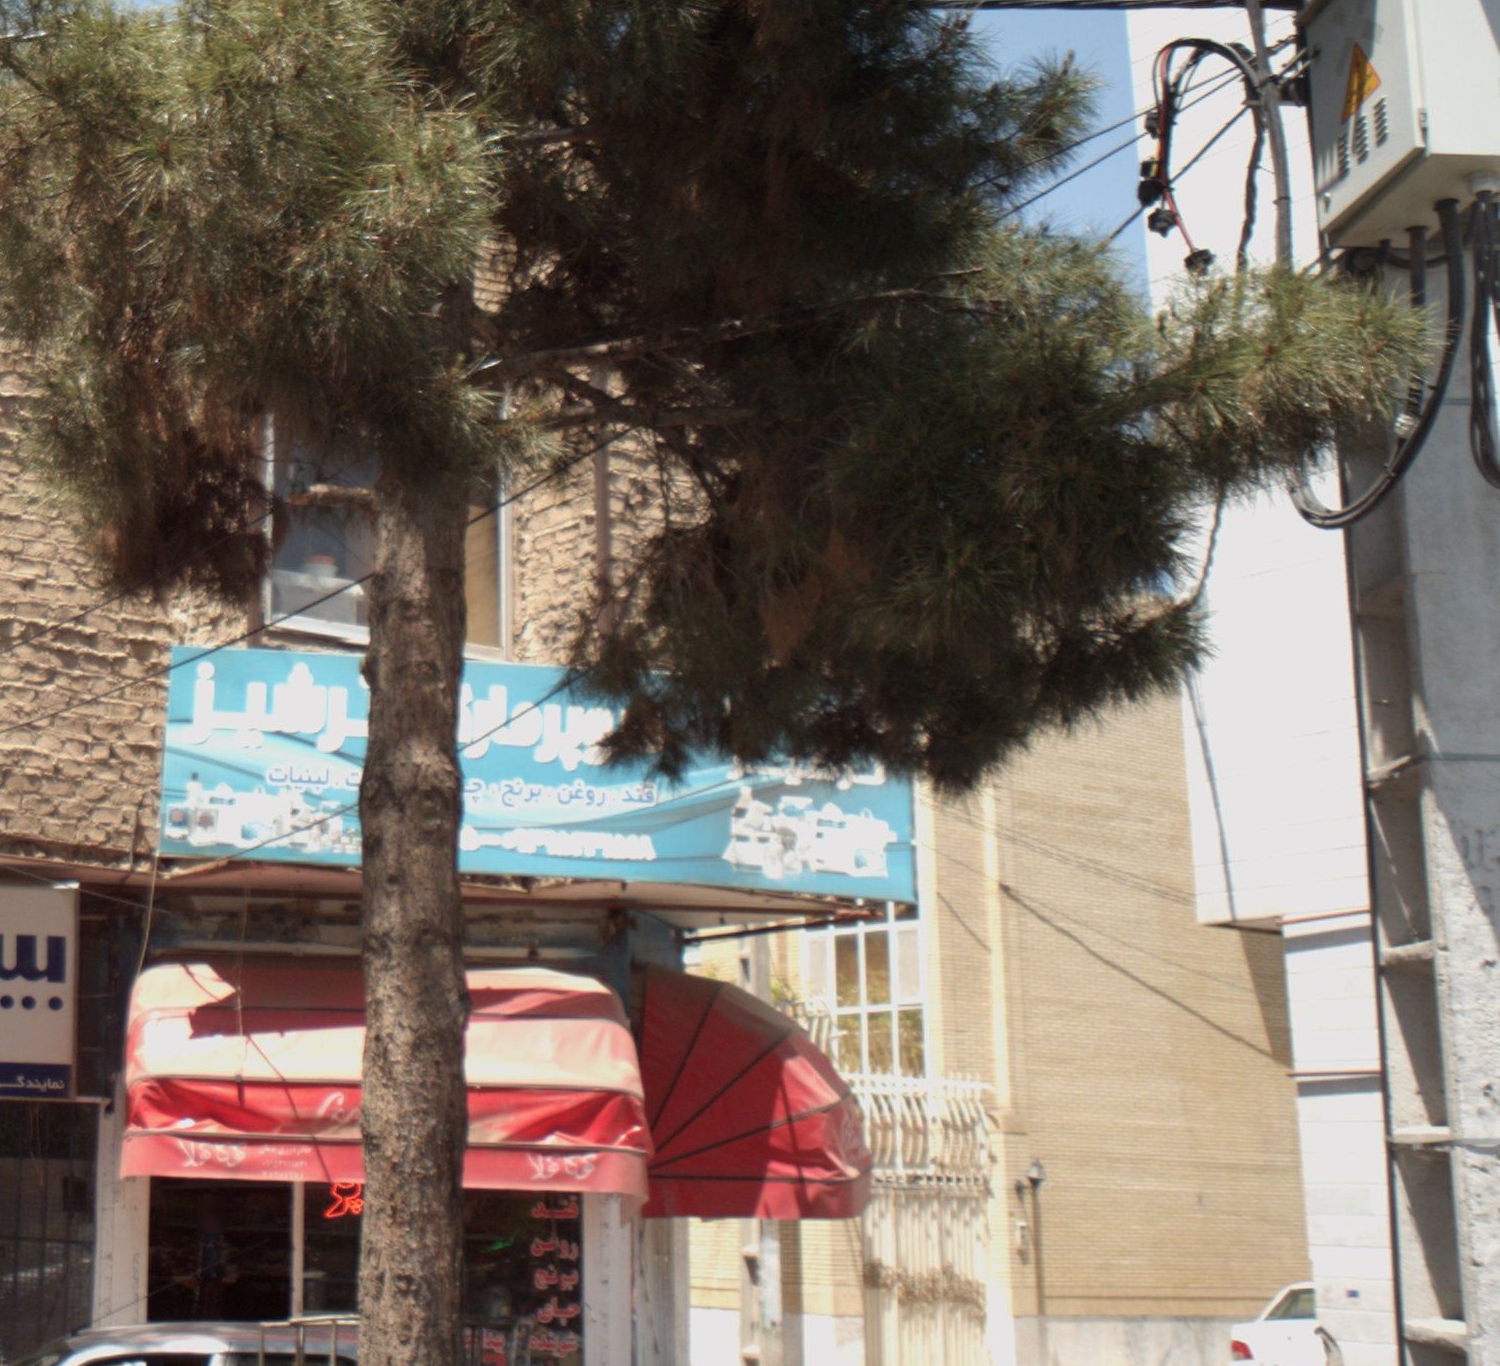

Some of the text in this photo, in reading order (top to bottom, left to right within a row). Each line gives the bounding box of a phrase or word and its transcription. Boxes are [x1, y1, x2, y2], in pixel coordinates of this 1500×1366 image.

[268, 766, 330, 790] لبنیات
[501, 780, 542, 807] برنج
[557, 783, 605, 807] روغن
[531, 1195, 579, 1219] قند
[531, 1237, 579, 1261] روغن
[534, 1263, 579, 1291] برنج
